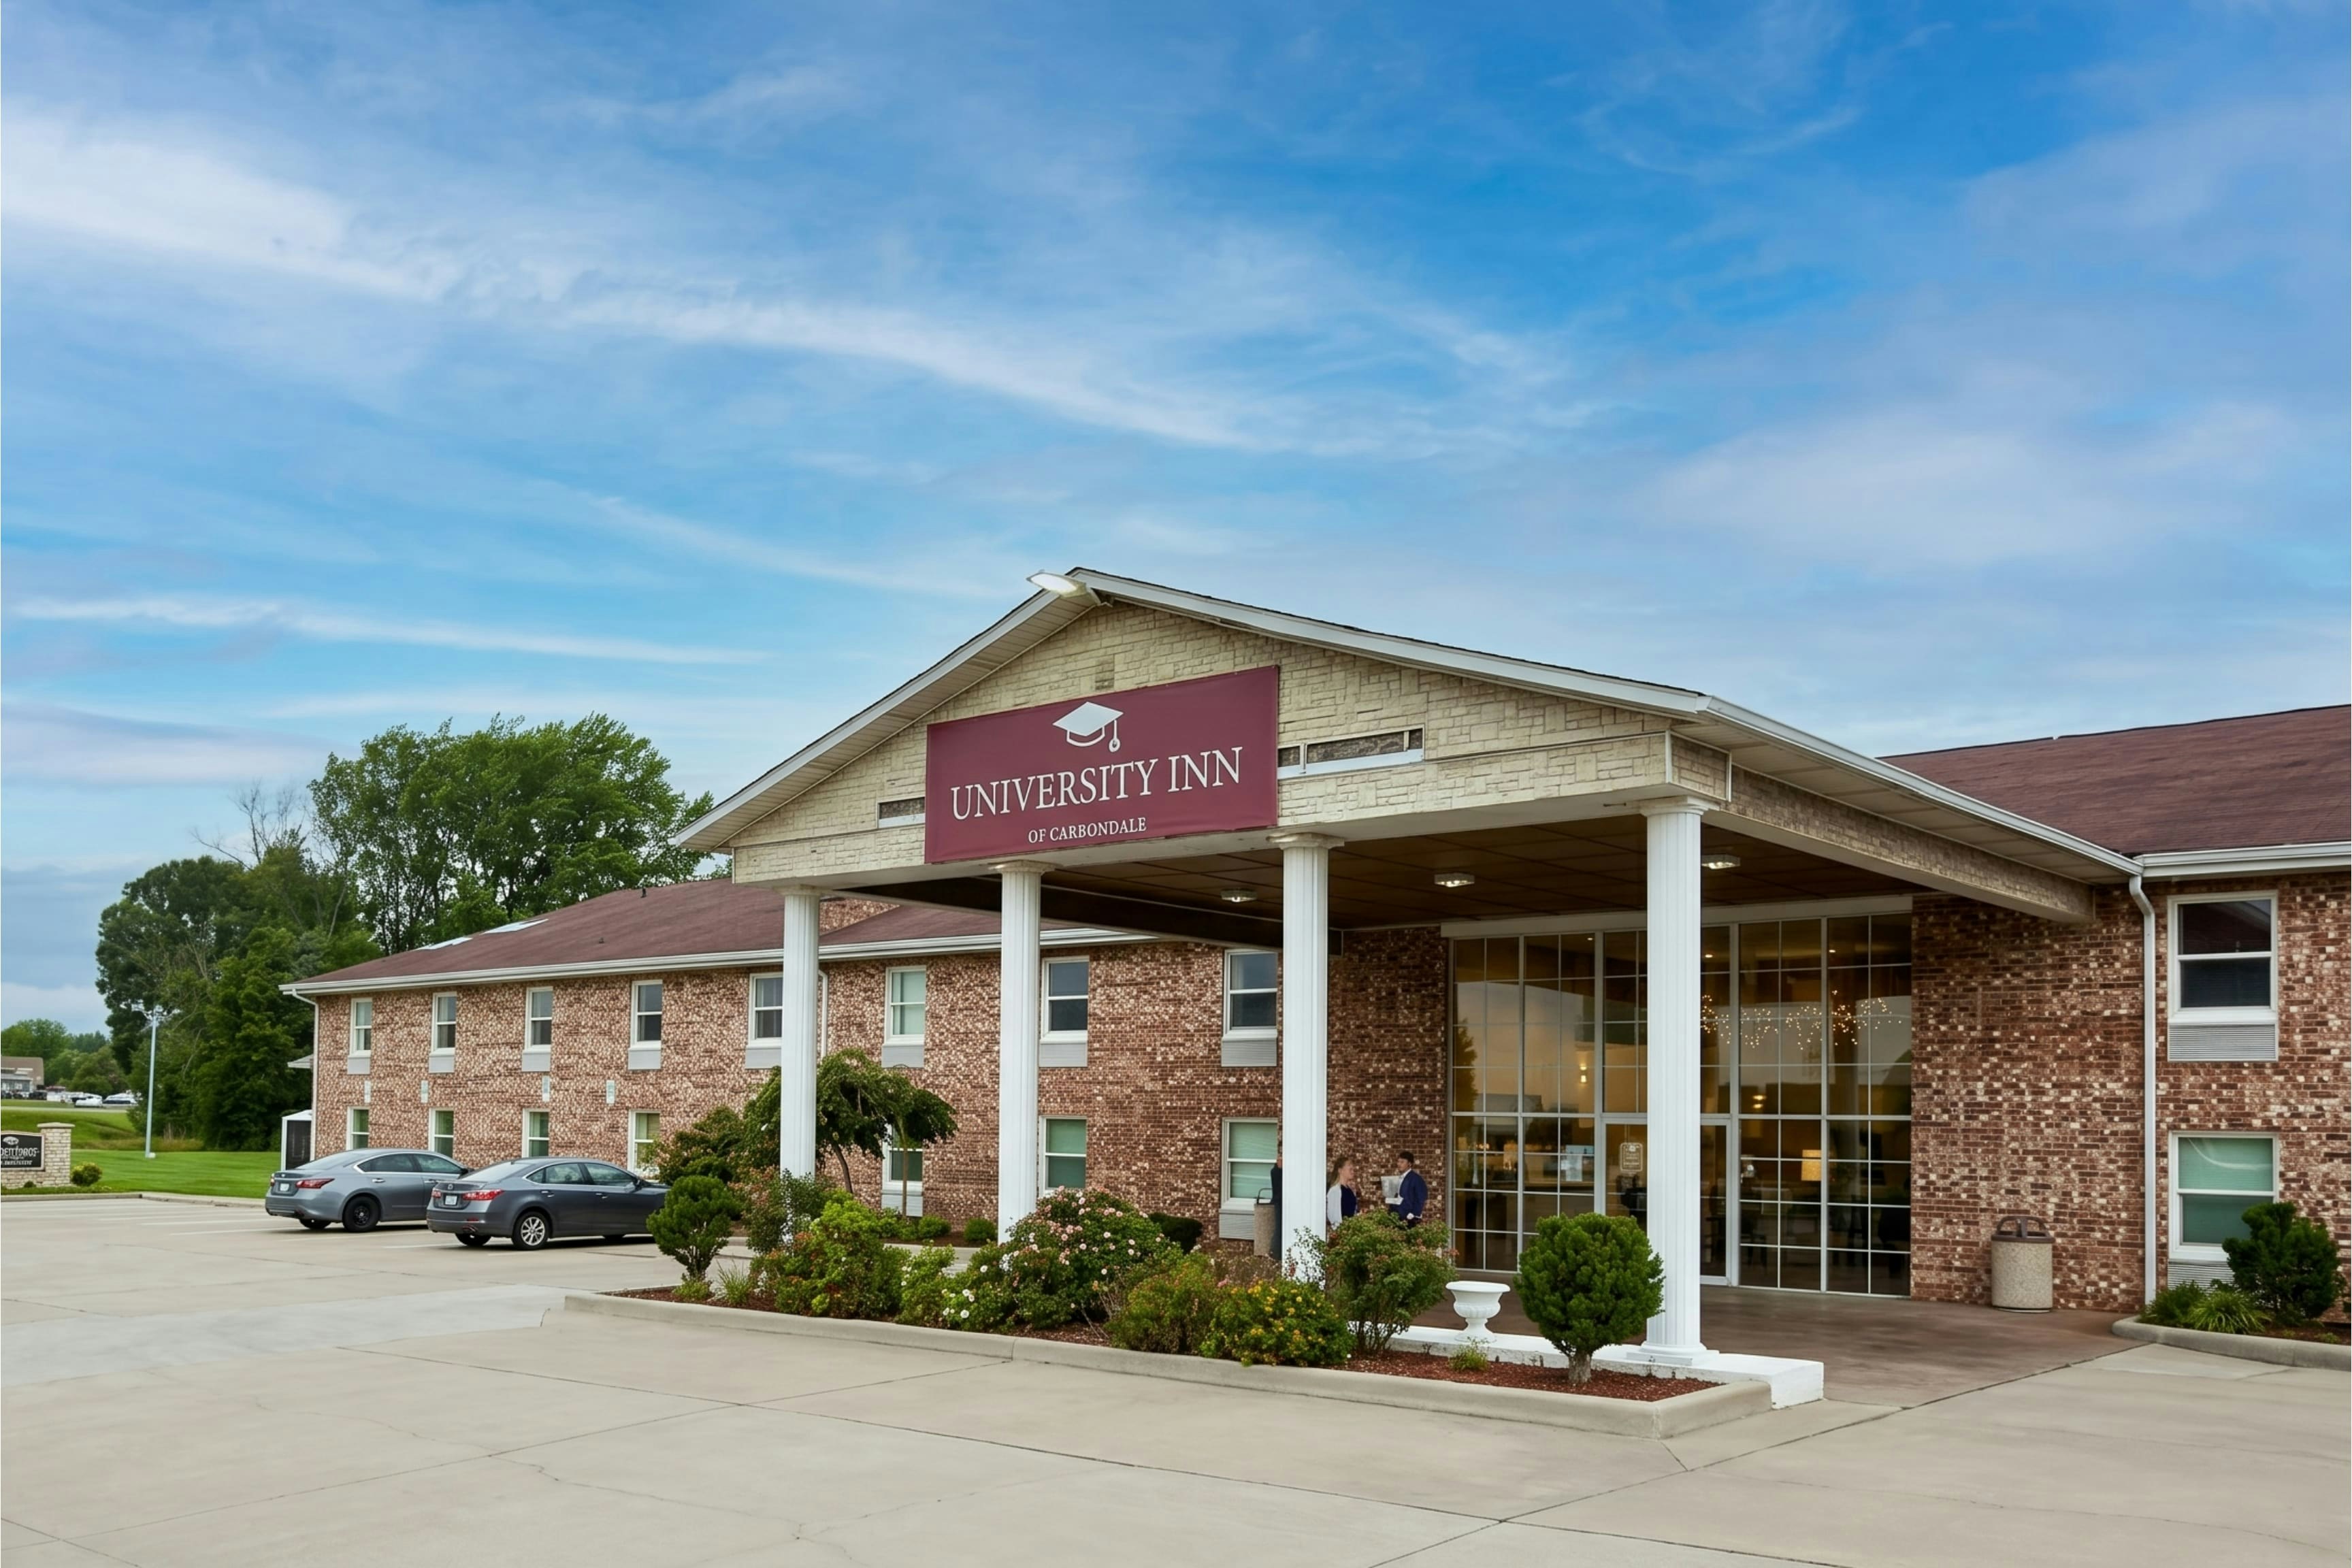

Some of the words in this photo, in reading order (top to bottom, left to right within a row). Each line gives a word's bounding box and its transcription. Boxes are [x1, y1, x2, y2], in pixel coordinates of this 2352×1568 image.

[951, 758, 1159, 821] UNIVERSITY
[1167, 746, 1243, 793] INN
[1028, 828, 1047, 844] OF
[1049, 817, 1147, 842] CARBONDALE
